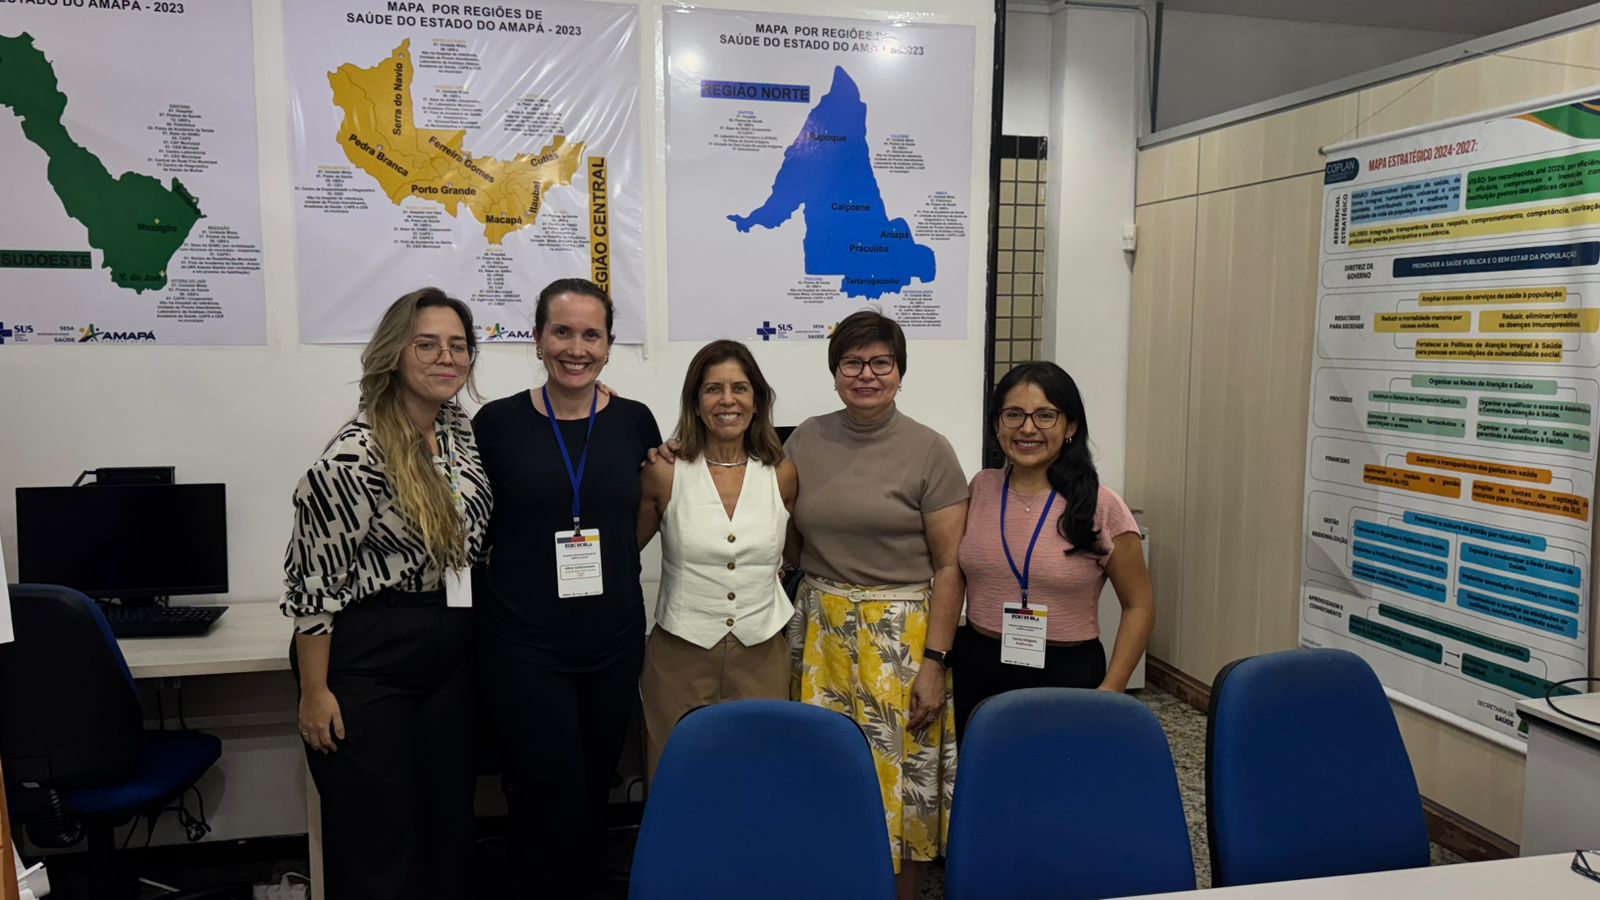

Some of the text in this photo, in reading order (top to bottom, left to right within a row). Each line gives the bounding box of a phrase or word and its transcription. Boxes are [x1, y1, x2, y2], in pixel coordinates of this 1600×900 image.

[154, 2, 184, 14] 2023
[387, 1, 543, 20] MAPA POR REGIÕES DE
[346, 10, 582, 36] SAÚDE DO ESTADO DO AMAPÁ 2023
[755, 23, 788, 35] MAPA
[794, 26, 818, 37] POR
[822, 26, 873, 40] REGIÕES
[720, 32, 760, 46] SAÚDE
[763, 37, 780, 47] DO
[784, 38, 830, 50] ESTADO
[832, 41, 849, 52] DO
[392, 62, 404, 136] Serra do Navio
[761, 87, 809, 102] NORTE
[349, 133, 409, 178] Pedra Branca
[428, 135, 495, 184] Ferreira Gomes
[1369, 139, 1478, 171] MAPA ESTRATÉGICO 2024-2027:
[1327, 160, 1355, 174] COPLAN
[411, 184, 476, 197] Porto Grande
[831, 202, 871, 213] Calçoene
[485, 214, 523, 226] Macapá
[592, 157, 609, 294] EGIÃO CENTRAL
[880, 230, 910, 240] Amapá
[0, 253, 90, 268] SUDOESTE
[1412, 261, 1440, 269] PROMOVER
[1446, 258, 1462, 266] SAÚDE
[1463, 257, 1486, 265] PÚBLICA
[1540, 250, 1577, 260] POPULAÇÃO
[1473, 293, 1496, 301] serviços
[1528, 291, 1562, 299] população
[14, 325, 34, 334] SUS
[778, 324, 793, 332] SUS
[102, 331, 156, 340] AMAPÁ
[1486, 381, 1508, 389] Atenção
[1506, 401, 1532, 410] qualificar
[1512, 408, 1535, 418] Atenção
[1477, 424, 1500, 432] Organizar
[1512, 426, 1538, 436] qualificar
[1508, 434, 1540, 443] Assistência
[1546, 437, 1564, 445] Saúde.
[1488, 466, 1507, 474] gastos
[1519, 469, 1538, 478] saúde
[1511, 489, 1532, 497] fontes
[1552, 496, 1580, 506] captação
[1516, 498, 1561, 510] financiamento
[1498, 533, 1530, 544] resultados
[1530, 560, 1544, 568] Rede
[1309, 603, 1342, 618] CONHECIMENTO
[1476, 699, 1510, 714] SECRETARIA
[1494, 714, 1514, 728] SAÚDE
